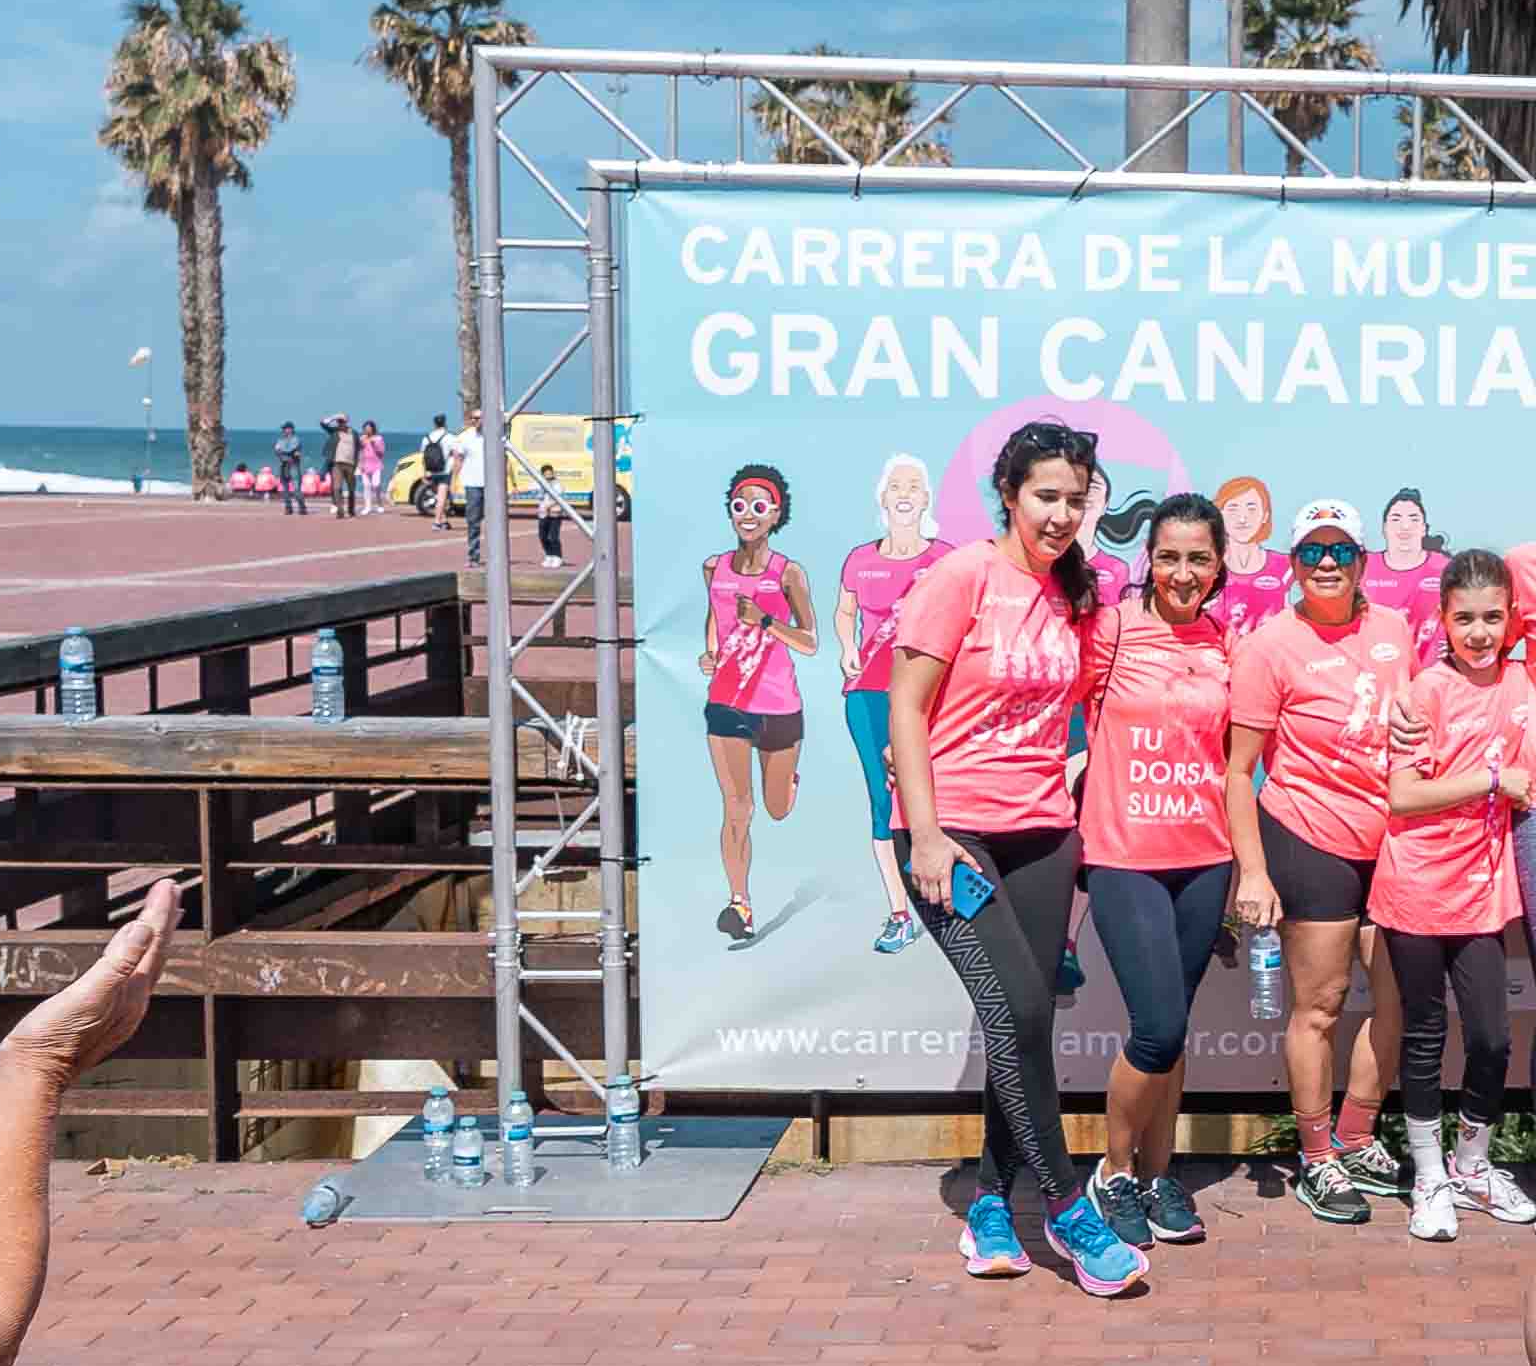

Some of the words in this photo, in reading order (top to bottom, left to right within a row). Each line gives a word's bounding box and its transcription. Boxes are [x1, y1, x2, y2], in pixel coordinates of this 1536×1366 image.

[681, 223, 1057, 291] CARRERA
[1084, 234, 1182, 292] DE
[1207, 235, 1306, 296] LA
[690, 311, 1001, 399] GRAN
[1128, 725, 1163, 751] TU
[1127, 792, 1204, 817] SUMA
